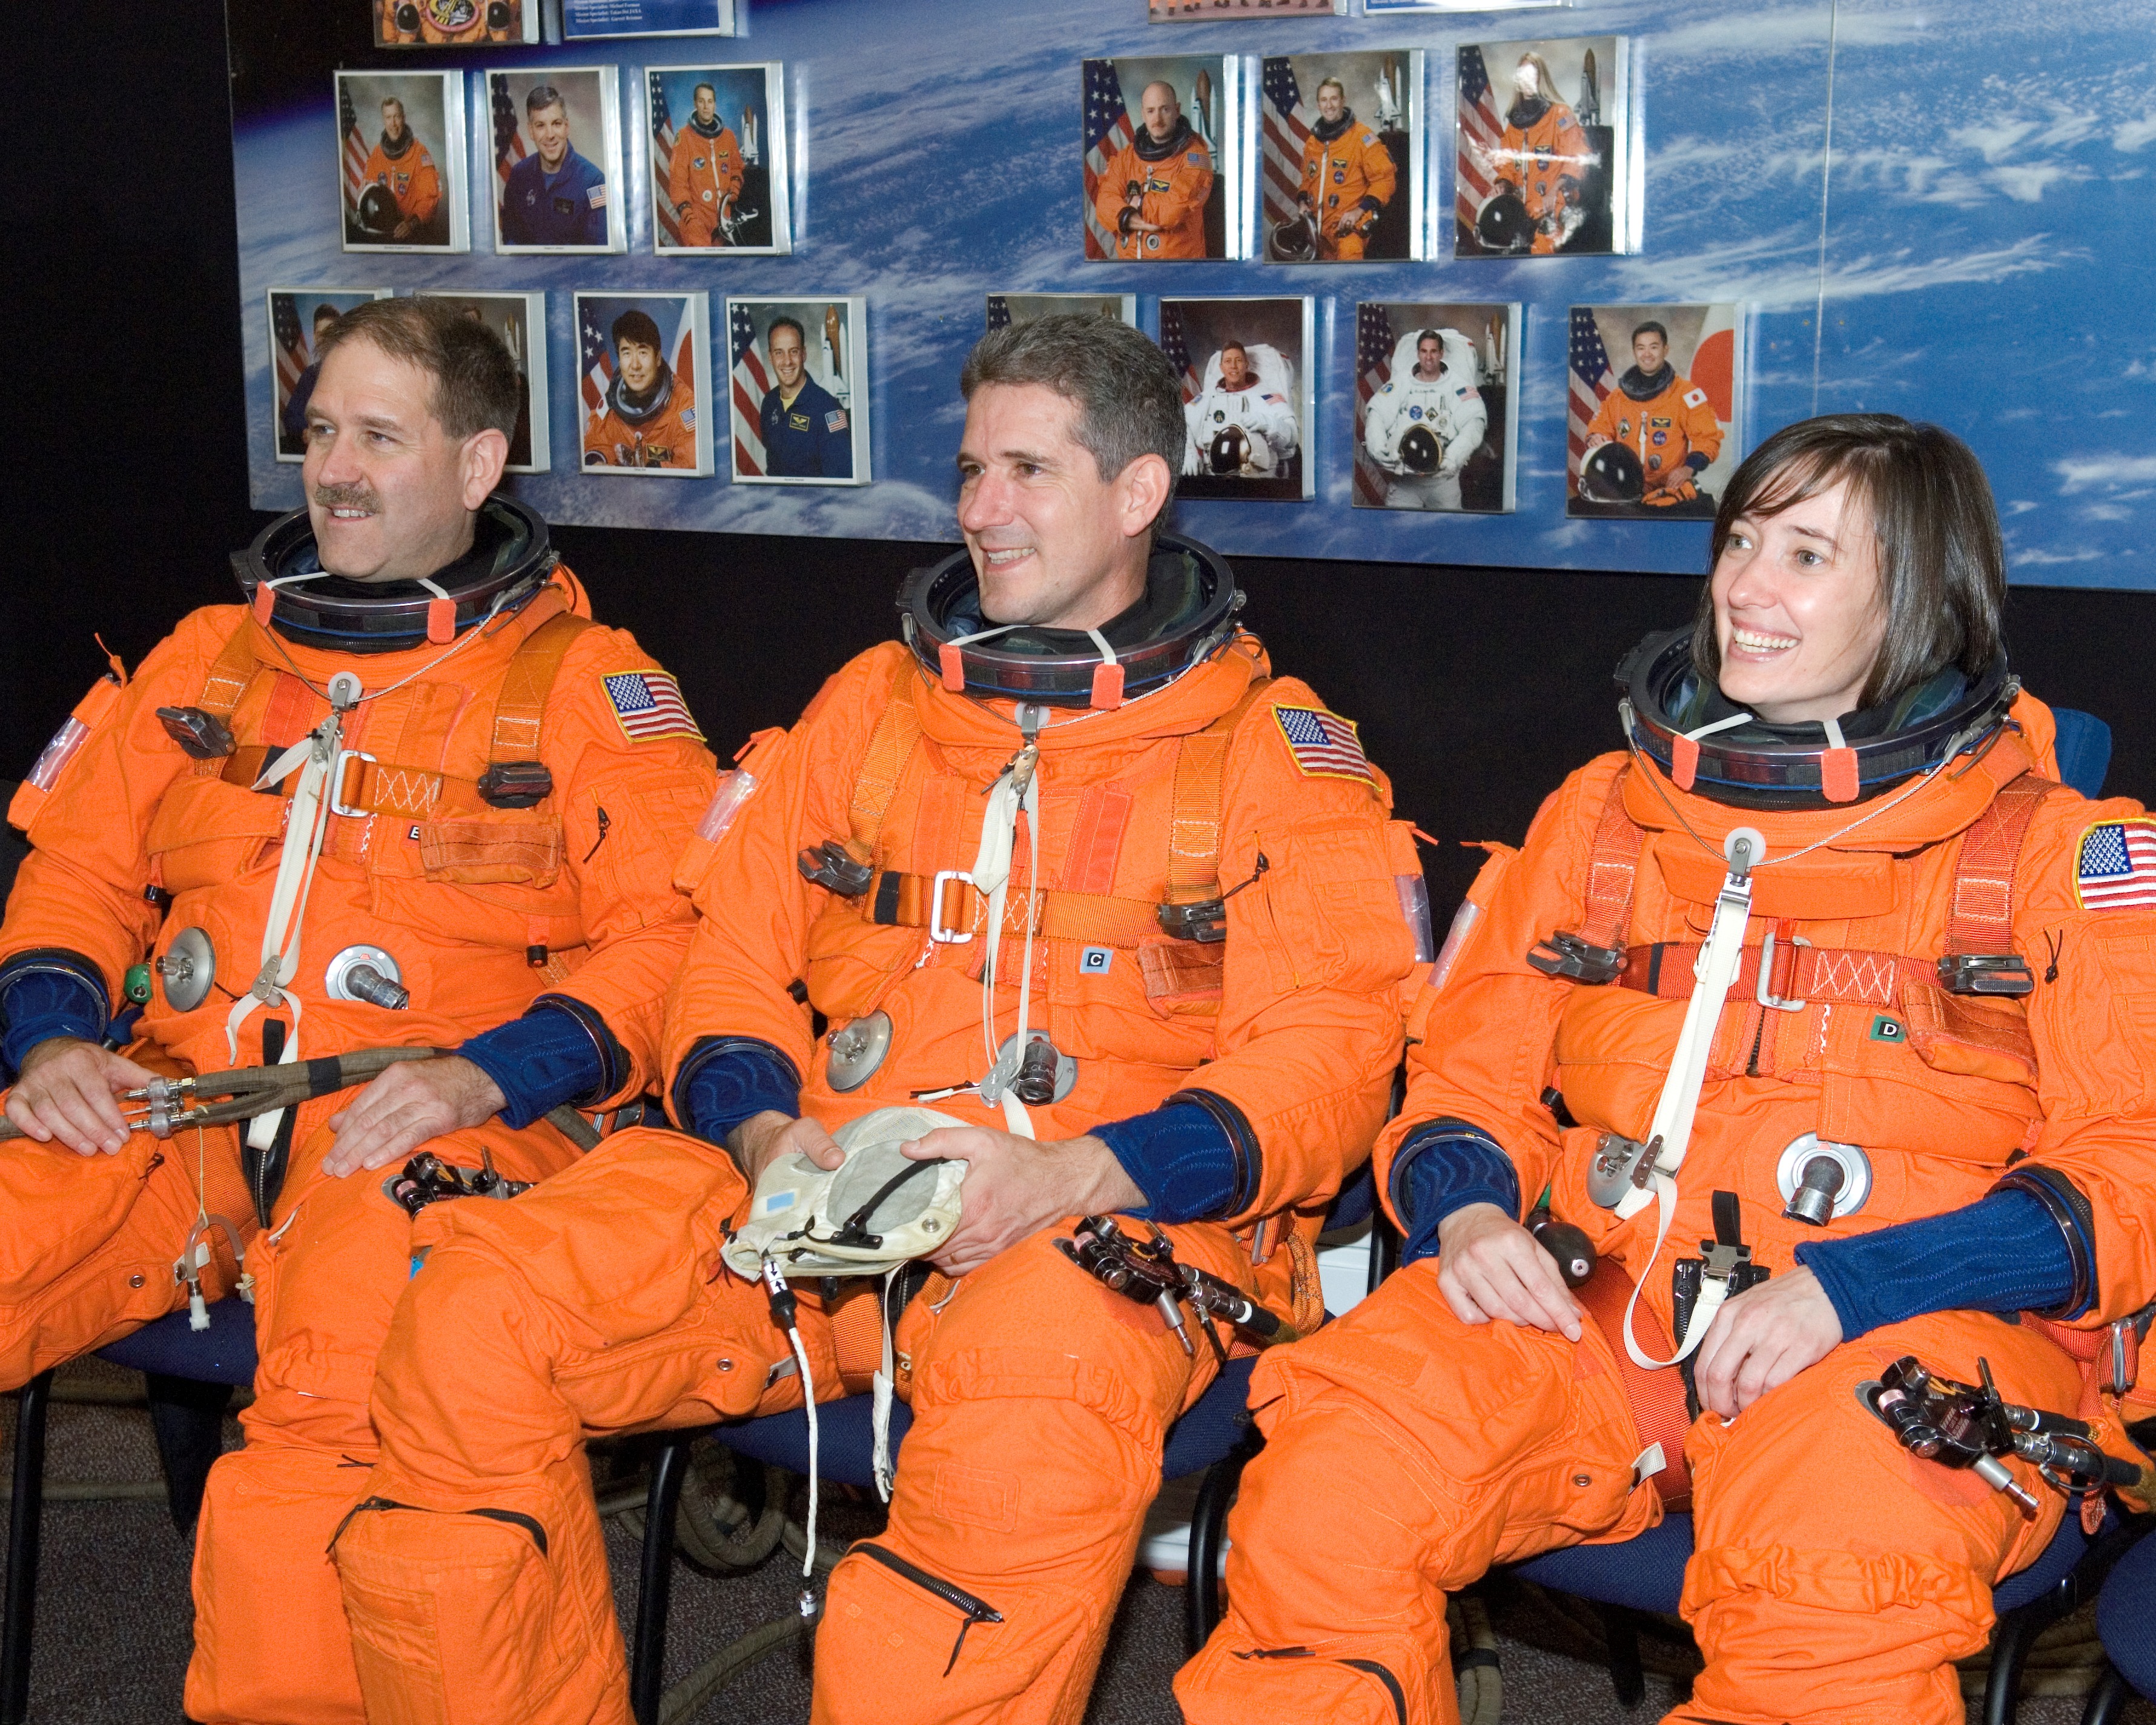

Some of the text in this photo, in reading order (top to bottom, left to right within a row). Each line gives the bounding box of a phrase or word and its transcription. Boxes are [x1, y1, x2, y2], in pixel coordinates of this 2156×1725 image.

[410, 826, 419, 839] E
[1090, 954, 1102, 965] C
[1883, 1023, 1897, 1035] D
